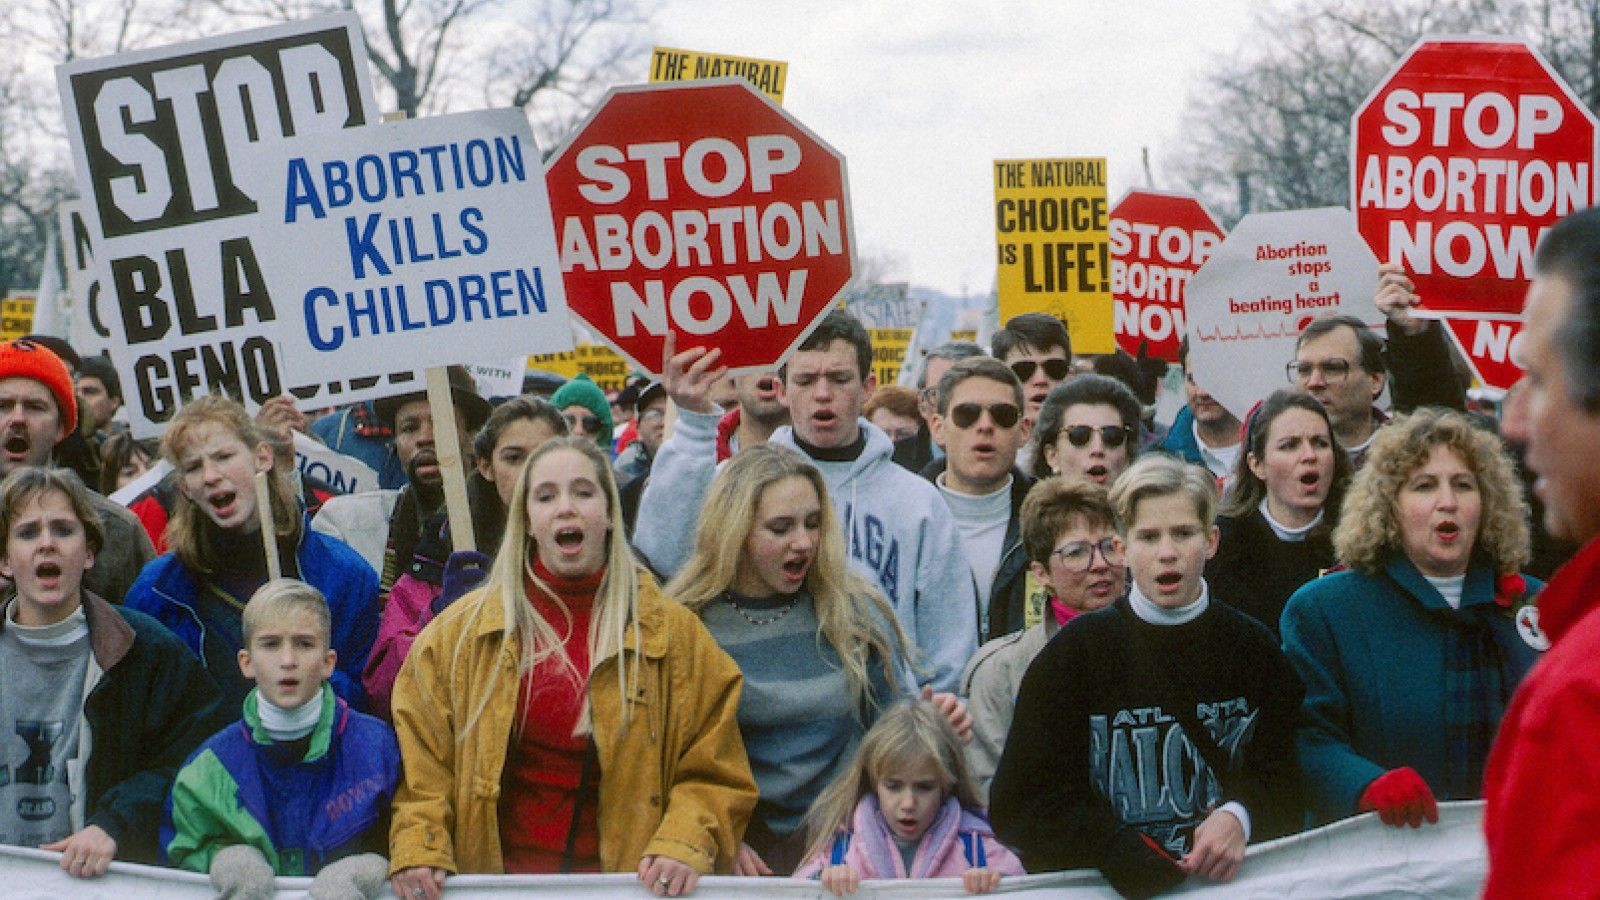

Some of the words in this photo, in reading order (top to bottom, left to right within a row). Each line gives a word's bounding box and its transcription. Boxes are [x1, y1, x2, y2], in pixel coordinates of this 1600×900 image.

[655, 51, 690, 81] THE
[694, 56, 781, 95] NATURAL
[1381, 88, 1564, 149] STOP
[284, 135, 526, 224] ABORTION
[576, 134, 802, 205] STOP
[996, 163, 1025, 188] THE
[1031, 161, 1106, 187] NATURAL
[1360, 154, 1589, 217] ABORTION
[562, 200, 843, 273] ABORTION
[997, 197, 1108, 232] CHOICE
[344, 207, 489, 280] KILLS
[1109, 218, 1221, 265] STOP
[1256, 241, 1328, 261] Abortion
[1388, 219, 1553, 280] NOW
[110, 236, 277, 345] BLA
[998, 244, 1017, 265] IS
[1023, 243, 1110, 293] LIFE!
[1288, 260, 1332, 278] stops
[1309, 282, 1319, 292] a
[303, 267, 548, 352] CHILDREN
[610, 269, 809, 337] NOW
[1229, 296, 1292, 315] beating
[1296, 292, 1340, 310] heart
[477, 365, 512, 380] WITH
[1112, 697, 1249, 727] ATLNTA
